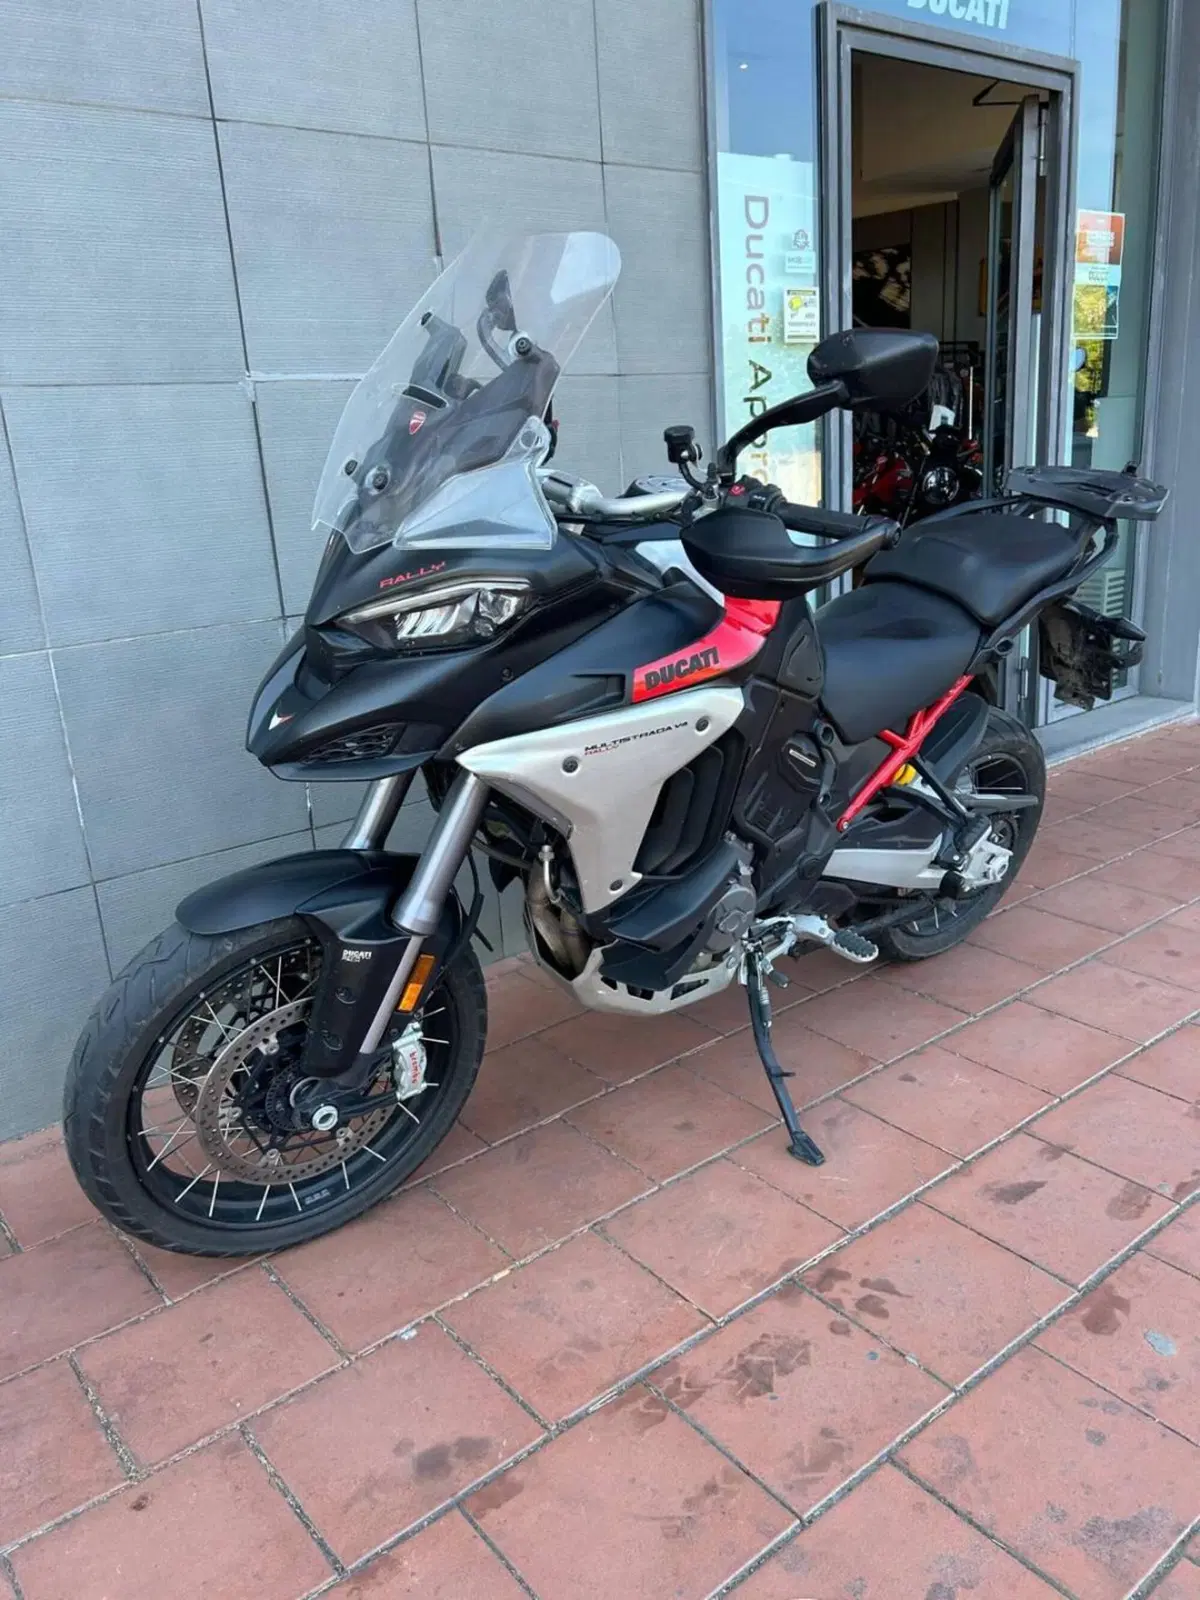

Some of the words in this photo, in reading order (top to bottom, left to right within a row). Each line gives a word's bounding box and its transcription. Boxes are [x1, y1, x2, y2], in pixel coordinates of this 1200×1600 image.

[907, 0, 1009, 29] CATI
[744, 194, 771, 343] Ducati
[379, 561, 446, 588] RALLY
[644, 647, 720, 691] DUCATI
[584, 726, 673, 751] MULTISTRADA
[342, 949, 373, 960] DUCATI
